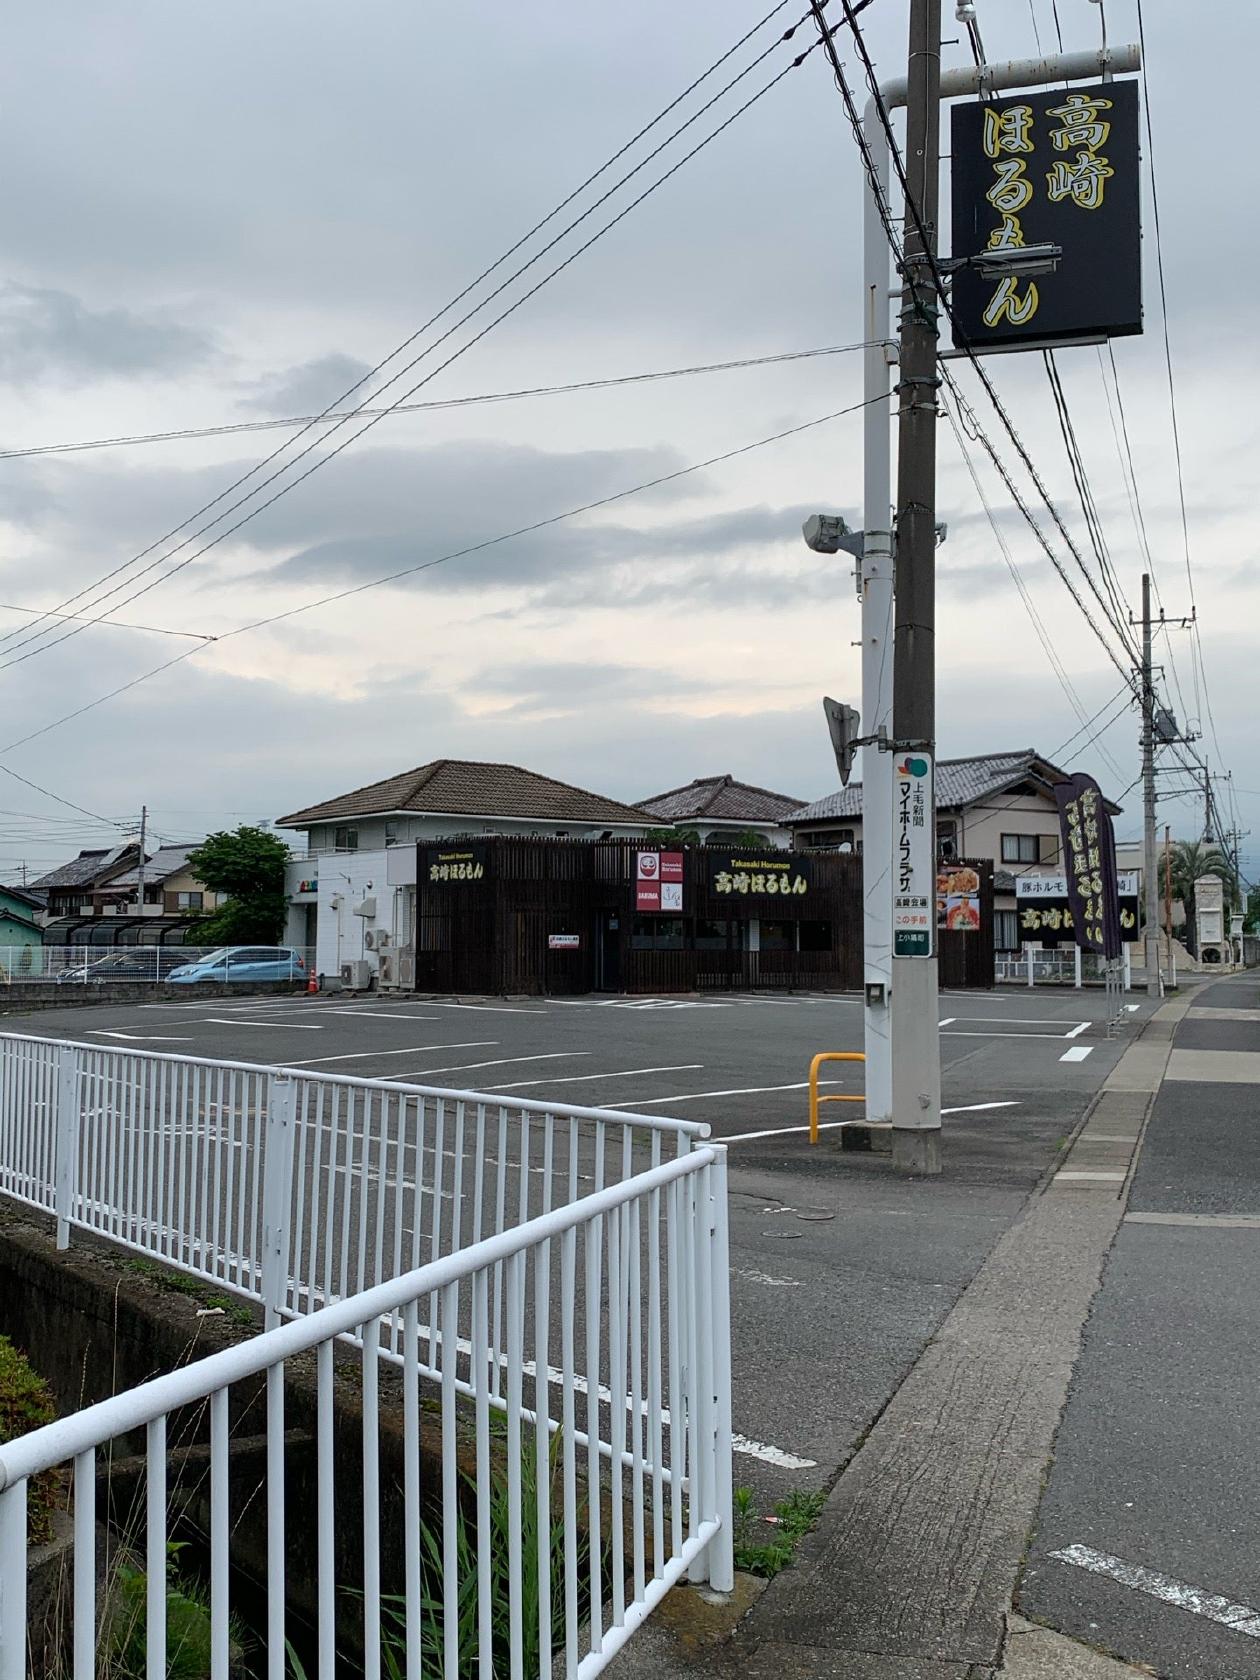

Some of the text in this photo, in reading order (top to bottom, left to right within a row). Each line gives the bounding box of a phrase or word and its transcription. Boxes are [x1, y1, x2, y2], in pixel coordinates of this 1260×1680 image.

[1045, 95, 1114, 209] 高崎
[913, 782, 924, 827] 上毛新聞
[430, 861, 483, 882] 高崎ほるもん
[731, 859, 760, 868] Takasaki
[714, 871, 807, 894] 高崎ほるもん
[896, 915, 928, 925] この手前
